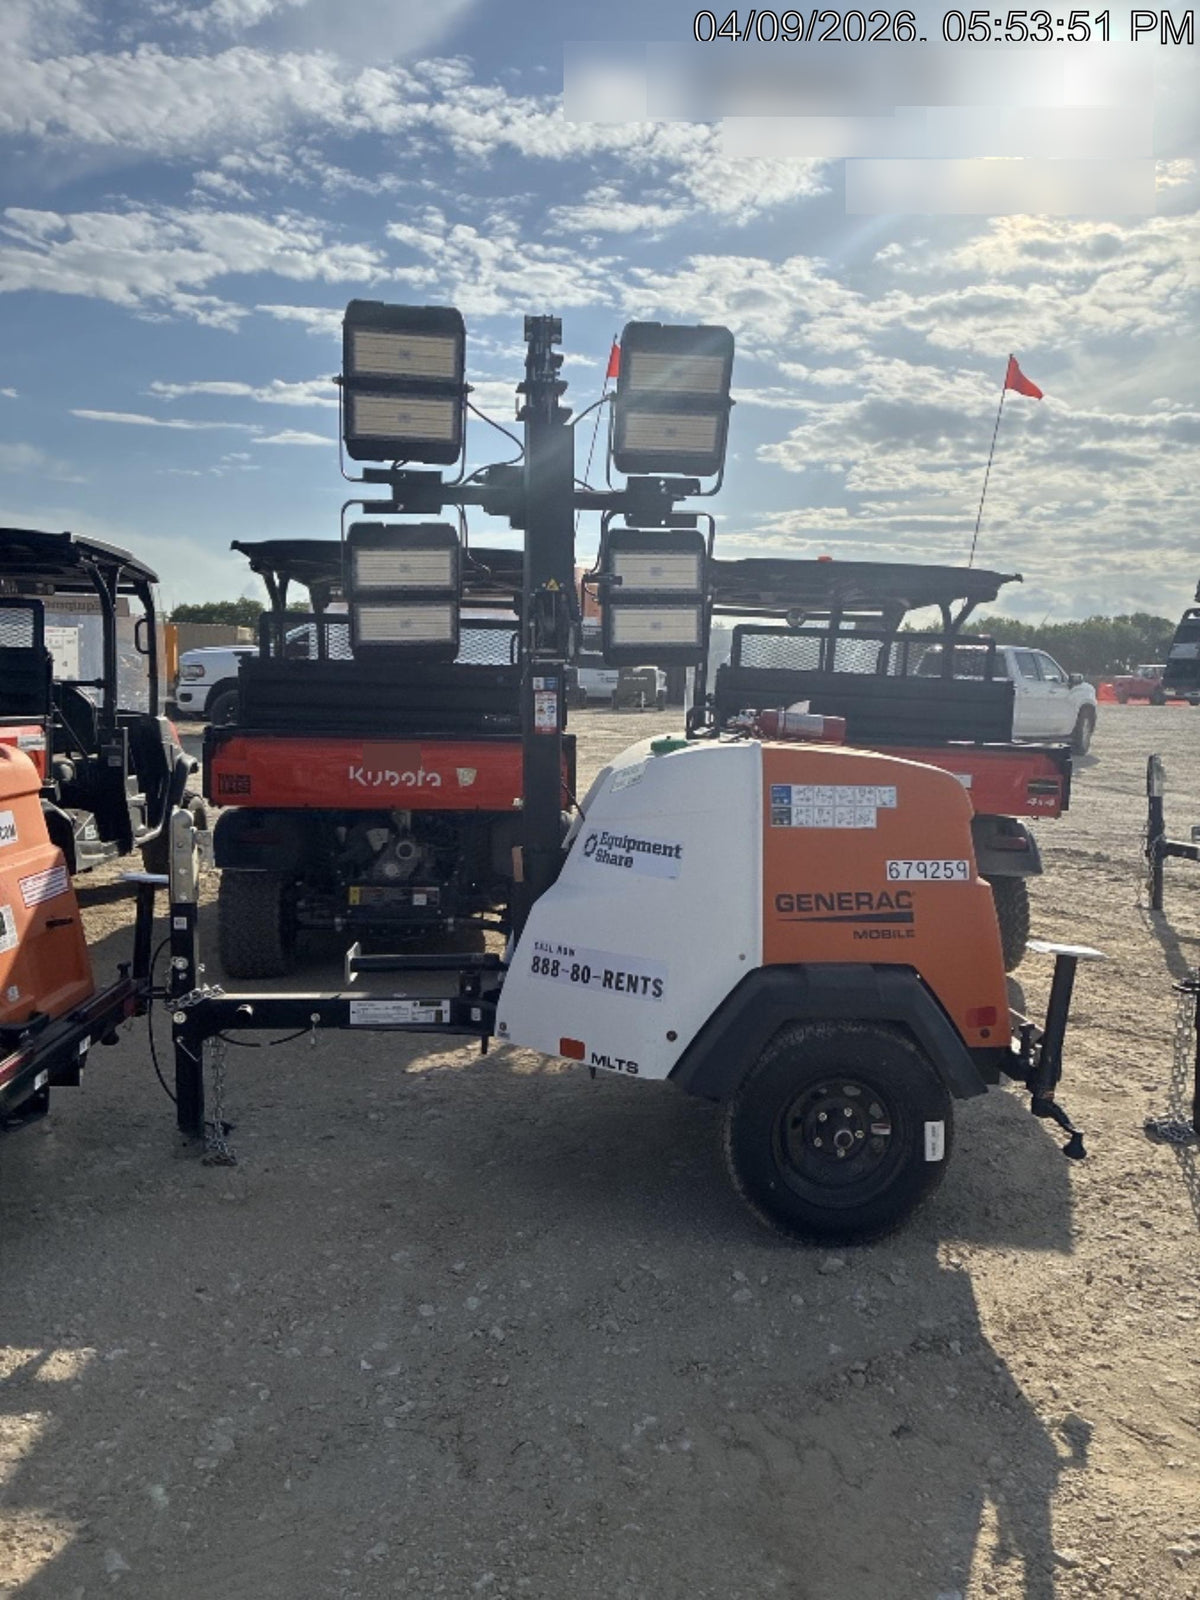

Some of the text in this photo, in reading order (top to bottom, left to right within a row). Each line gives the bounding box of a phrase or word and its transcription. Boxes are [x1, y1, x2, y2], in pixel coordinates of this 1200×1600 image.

[348, 765, 442, 786] Kubota
[598, 831, 683, 859] Equipment
[595, 847, 634, 868] Share
[888, 861, 967, 879] 679259
[775, 890, 913, 912] GENERAC
[852, 929, 916, 940] MOBILE
[530, 955, 664, 998] 888-80-RENTS
[591, 1051, 639, 1075] MLTS
